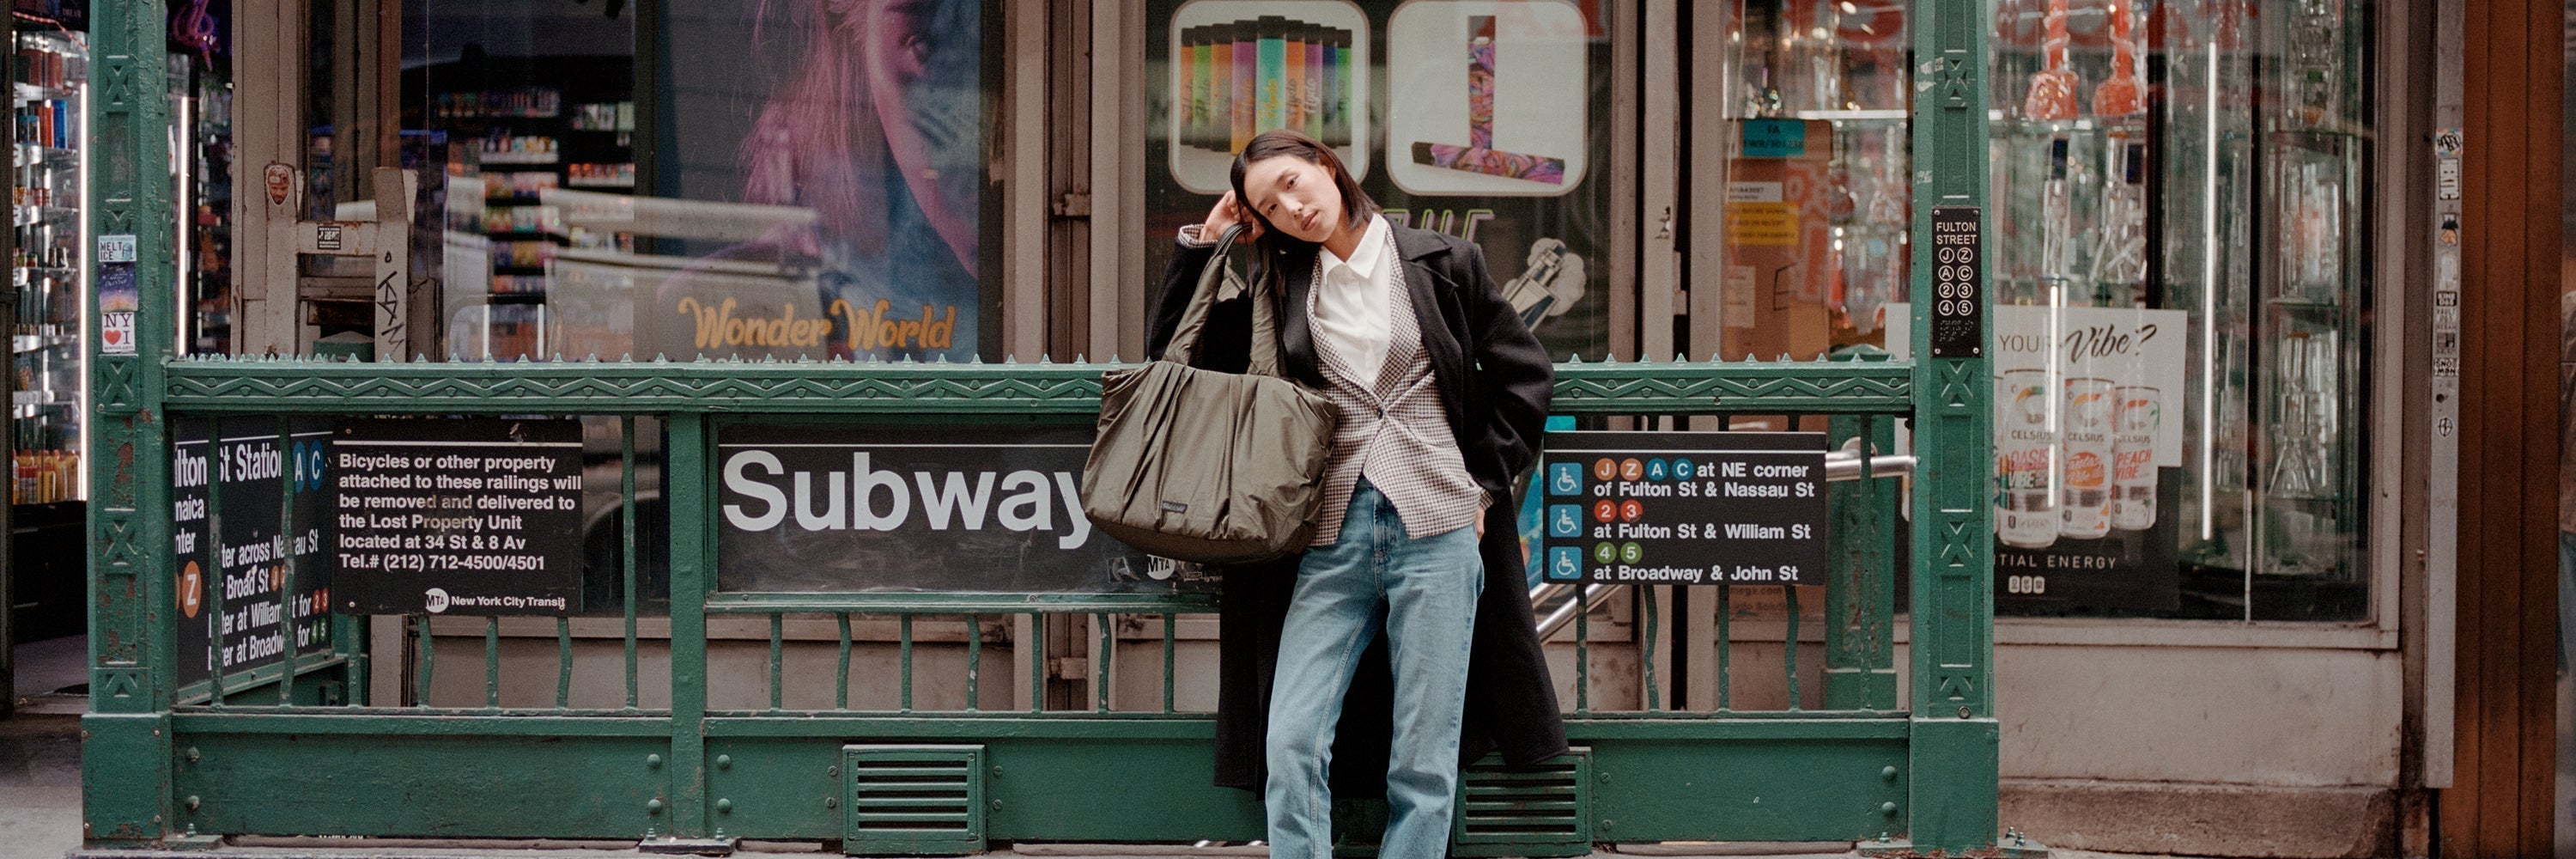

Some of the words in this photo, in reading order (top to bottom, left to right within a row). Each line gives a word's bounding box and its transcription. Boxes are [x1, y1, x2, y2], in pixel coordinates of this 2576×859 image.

[1935, 222, 1977, 232] FULTON
[100, 242, 122, 252] MELT
[1935, 235, 1978, 245] STREET
[100, 251, 113, 260] ICE
[104, 314, 133, 327] NY
[677, 296, 833, 350] Wonder
[829, 297, 957, 350] World
[123, 331, 131, 344] I
[1999, 334, 2050, 353] YOU
[2065, 323, 2158, 364] Vibe?
[2011, 430, 2052, 441] CELSIUS
[2068, 432, 2105, 442] CELSIUS
[339, 454, 410, 472] Bicycles
[413, 457, 432, 469] or
[436, 454, 481, 469] other
[484, 455, 556, 473] property
[2117, 448, 2153, 466] PEACH
[1697, 463, 1715, 478] at
[1722, 462, 1747, 477] NE
[1753, 465, 1809, 478] corner
[2114, 467, 2140, 481] VIBE
[339, 473, 410, 489] attached
[415, 476, 432, 489] to
[435, 474, 483, 490] these
[487, 475, 550, 494] railings
[553, 476, 581, 490] will
[1594, 482, 1613, 497] of
[1619, 481, 1671, 497] Fulton
[1678, 481, 1698, 497] St
[1704, 482, 1717, 497] &
[1724, 482, 1788, 497] Nassau
[1795, 482, 1814, 497] St
[339, 493, 360, 509] be
[364, 494, 437, 509] removed
[441, 495, 472, 509] and
[477, 495, 554, 510] delivered
[557, 497, 575, 509] to
[723, 449, 1093, 550] Subway
[339, 514, 366, 529] the
[370, 514, 407, 529] Lost
[412, 515, 483, 533] Property
[488, 515, 522, 530] Unit
[1594, 524, 1612, 539] at
[1619, 523, 1670, 539] Fulton
[1677, 523, 1697, 539] St
[1704, 523, 1716, 539] &
[1724, 523, 1784, 539] William
[1791, 524, 1811, 539] St
[239, 541, 270, 566] across
[273, 533, 306, 560] Naau
[309, 528, 319, 554] St
[339, 534, 401, 549] located
[404, 535, 421, 549] at
[424, 535, 445, 549] 34
[449, 535, 468, 550] St
[471, 535, 484, 550] &
[489, 535, 499, 550] 8
[503, 535, 526, 550] Av
[339, 554, 379, 569] Tel.#
[383, 554, 425, 572] (212)
[429, 555, 544, 570] 712-4500/4501
[1148, 557, 1170, 573] MTA
[1994, 554, 2038, 568] TIAL
[2047, 554, 2117, 570] ENERGY
[1594, 566, 1612, 581] at
[1619, 565, 1703, 583] Broadway
[1710, 566, 1722, 581] &
[1730, 566, 1772, 581] John
[1778, 566, 1798, 581] St
[227, 568, 256, 600] Broad
[258, 568, 269, 594] St
[427, 594, 444, 606] MTA
[451, 596, 476, 606] New
[477, 596, 501, 606] York
[503, 596, 526, 608] City
[526, 596, 566, 606] Transit
[237, 606, 247, 631] at
[299, 594, 312, 618] for
[236, 637, 247, 663] at
[250, 630, 284, 660] Broadw
[297, 624, 310, 648] for
